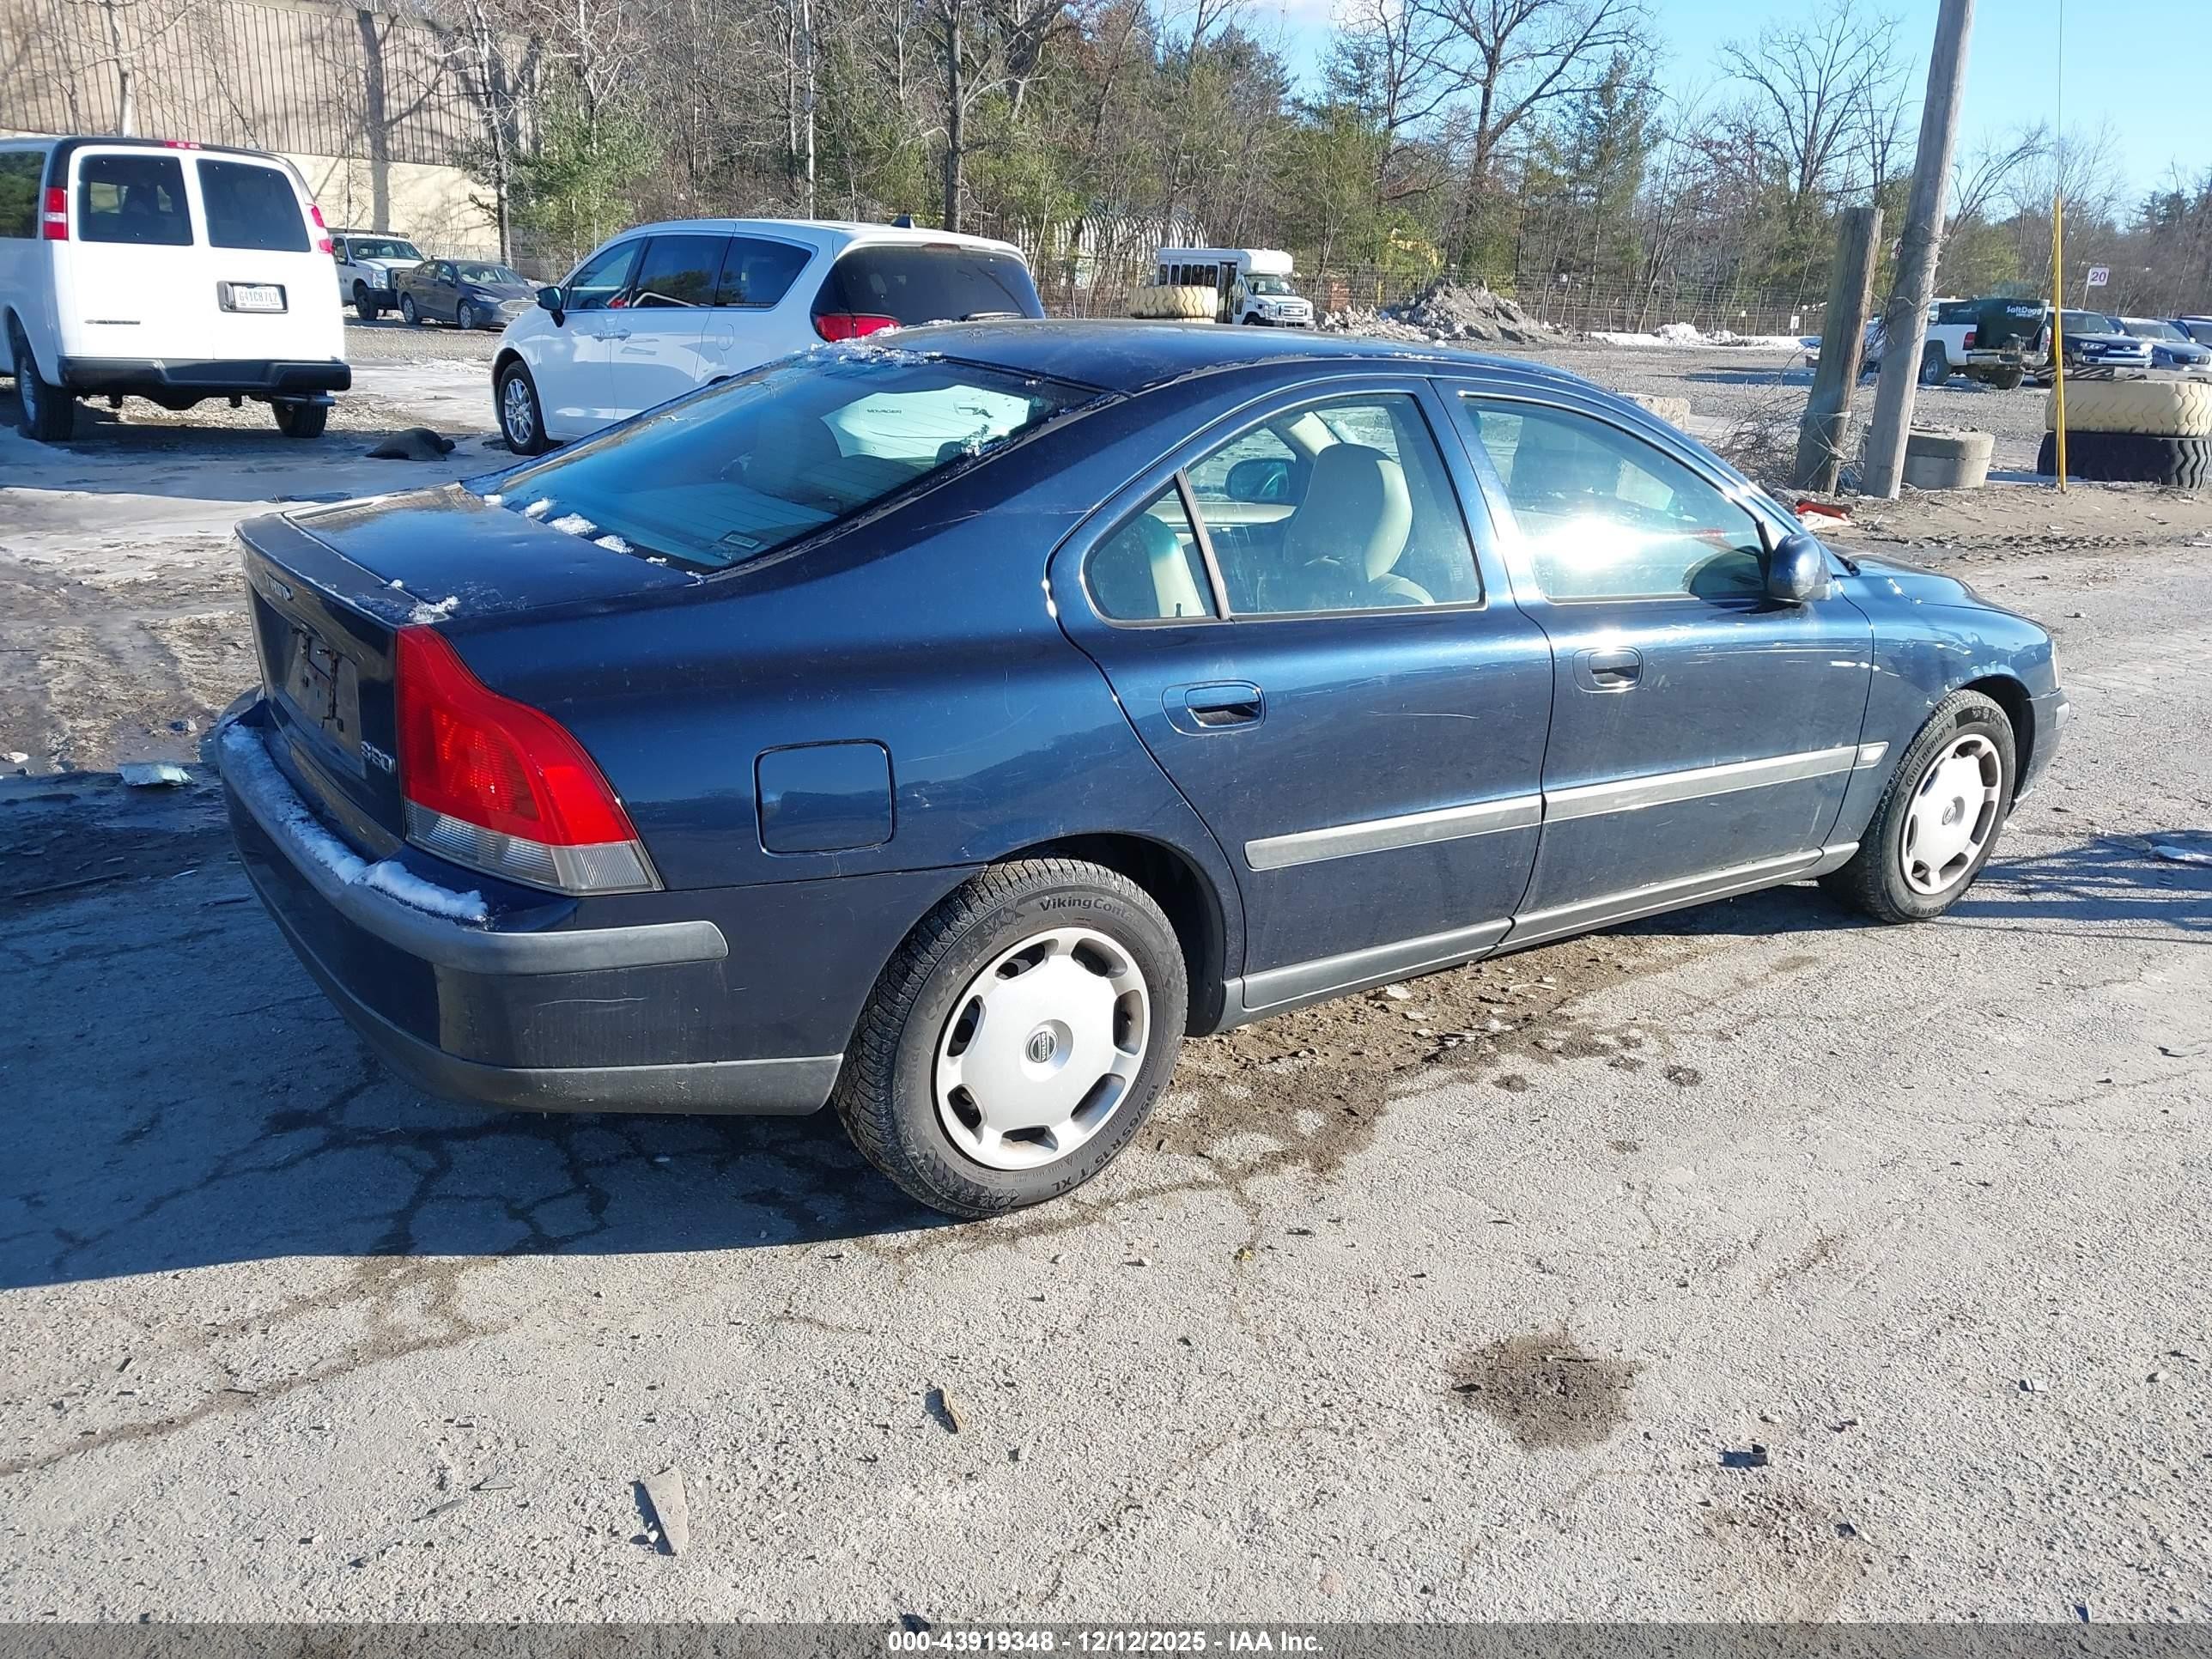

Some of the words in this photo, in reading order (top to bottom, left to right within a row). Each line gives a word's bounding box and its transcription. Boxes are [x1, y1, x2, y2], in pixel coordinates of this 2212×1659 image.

[2092, 271, 2106, 282] 20
[1122, 1083, 1159, 1139] 195/65
[1051, 1176, 1073, 1192] XL
